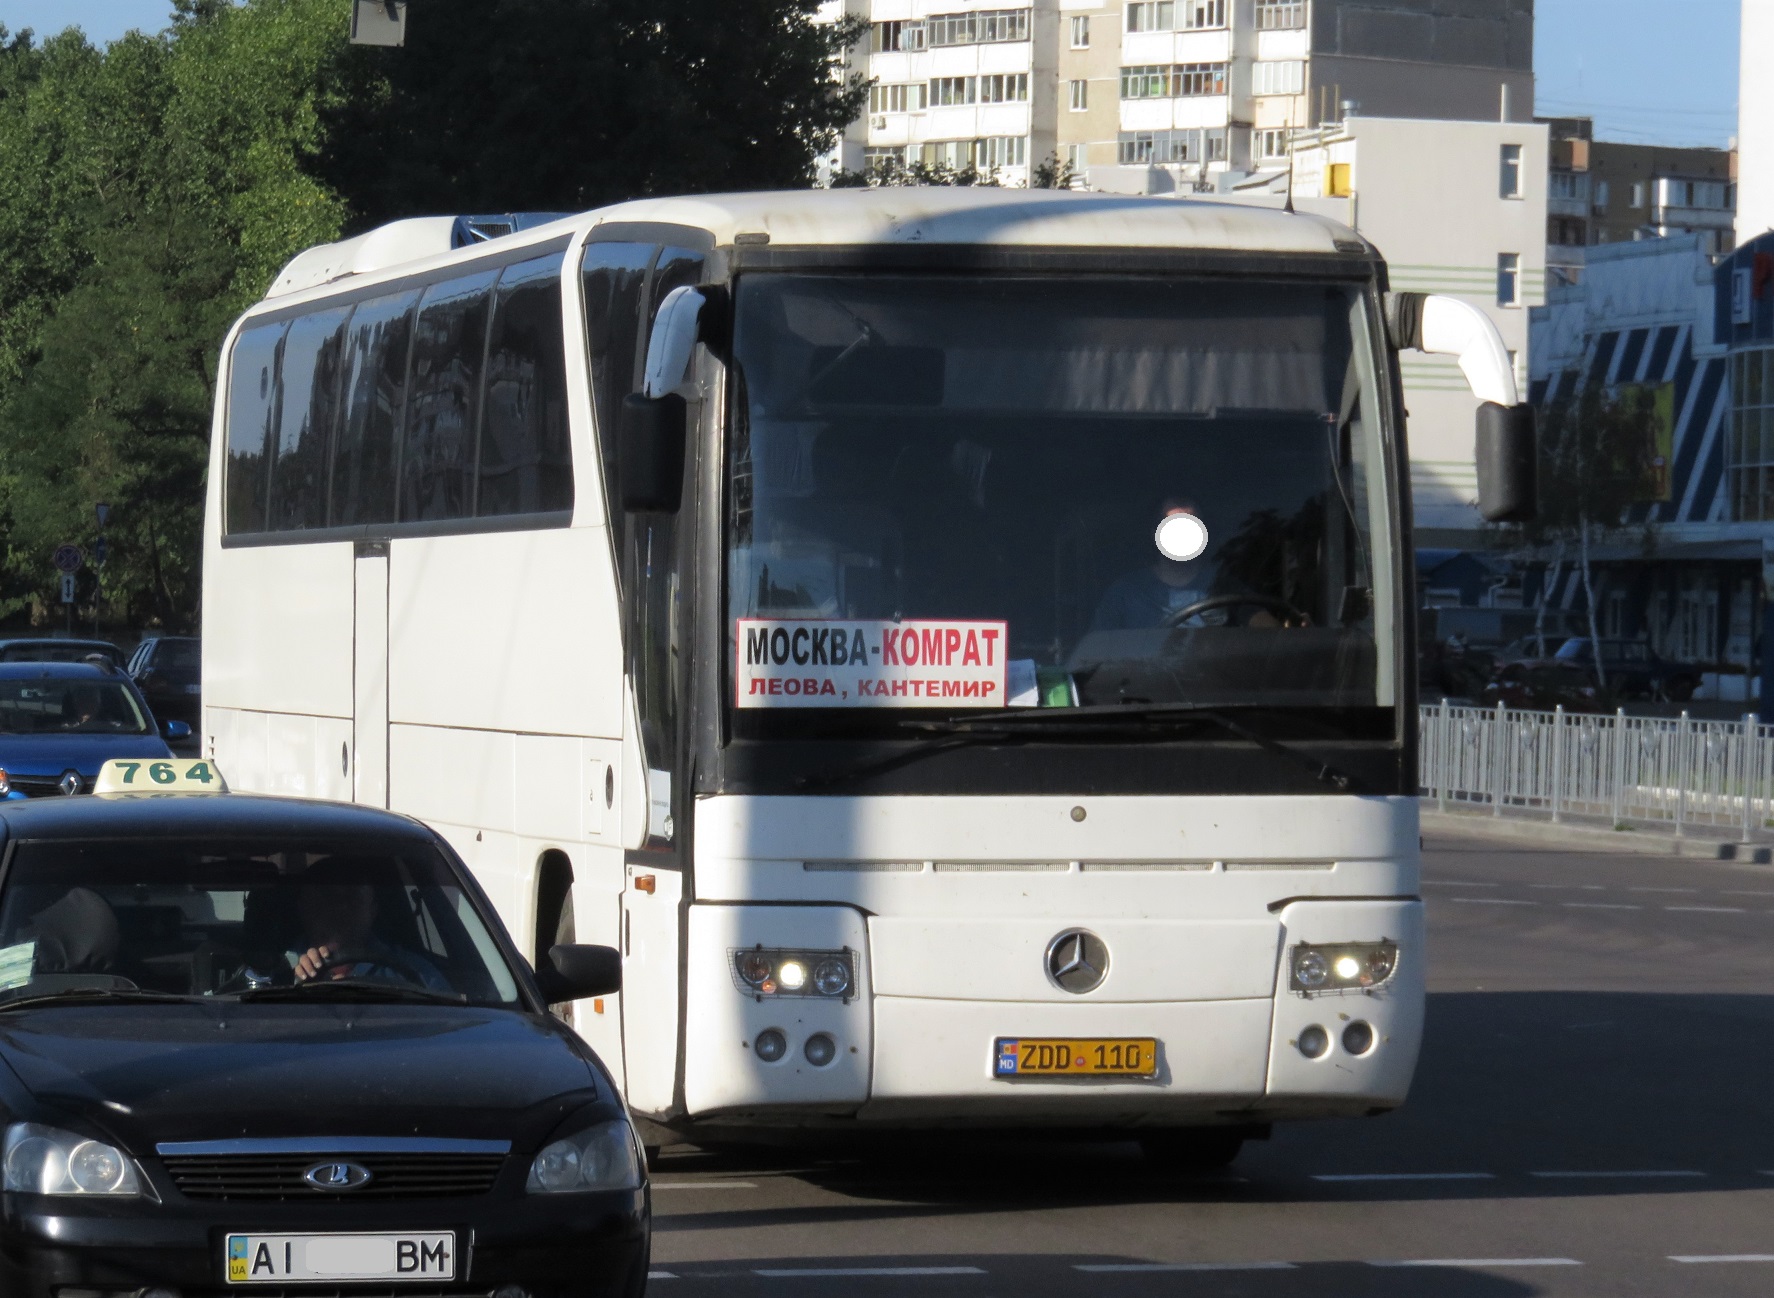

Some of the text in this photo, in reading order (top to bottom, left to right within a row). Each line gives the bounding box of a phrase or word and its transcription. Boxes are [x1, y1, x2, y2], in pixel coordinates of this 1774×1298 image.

[746, 627, 999, 667] МОСКВА-КОМРАТ
[858, 679, 996, 698] КАНТЕМИР
[115, 762, 213, 784] 764
[999, 1058, 1014, 1070] MD
[1020, 1044, 1141, 1070] ZDD 110
[395, 1239, 445, 1273] BM
[231, 1265, 246, 1275] UA
